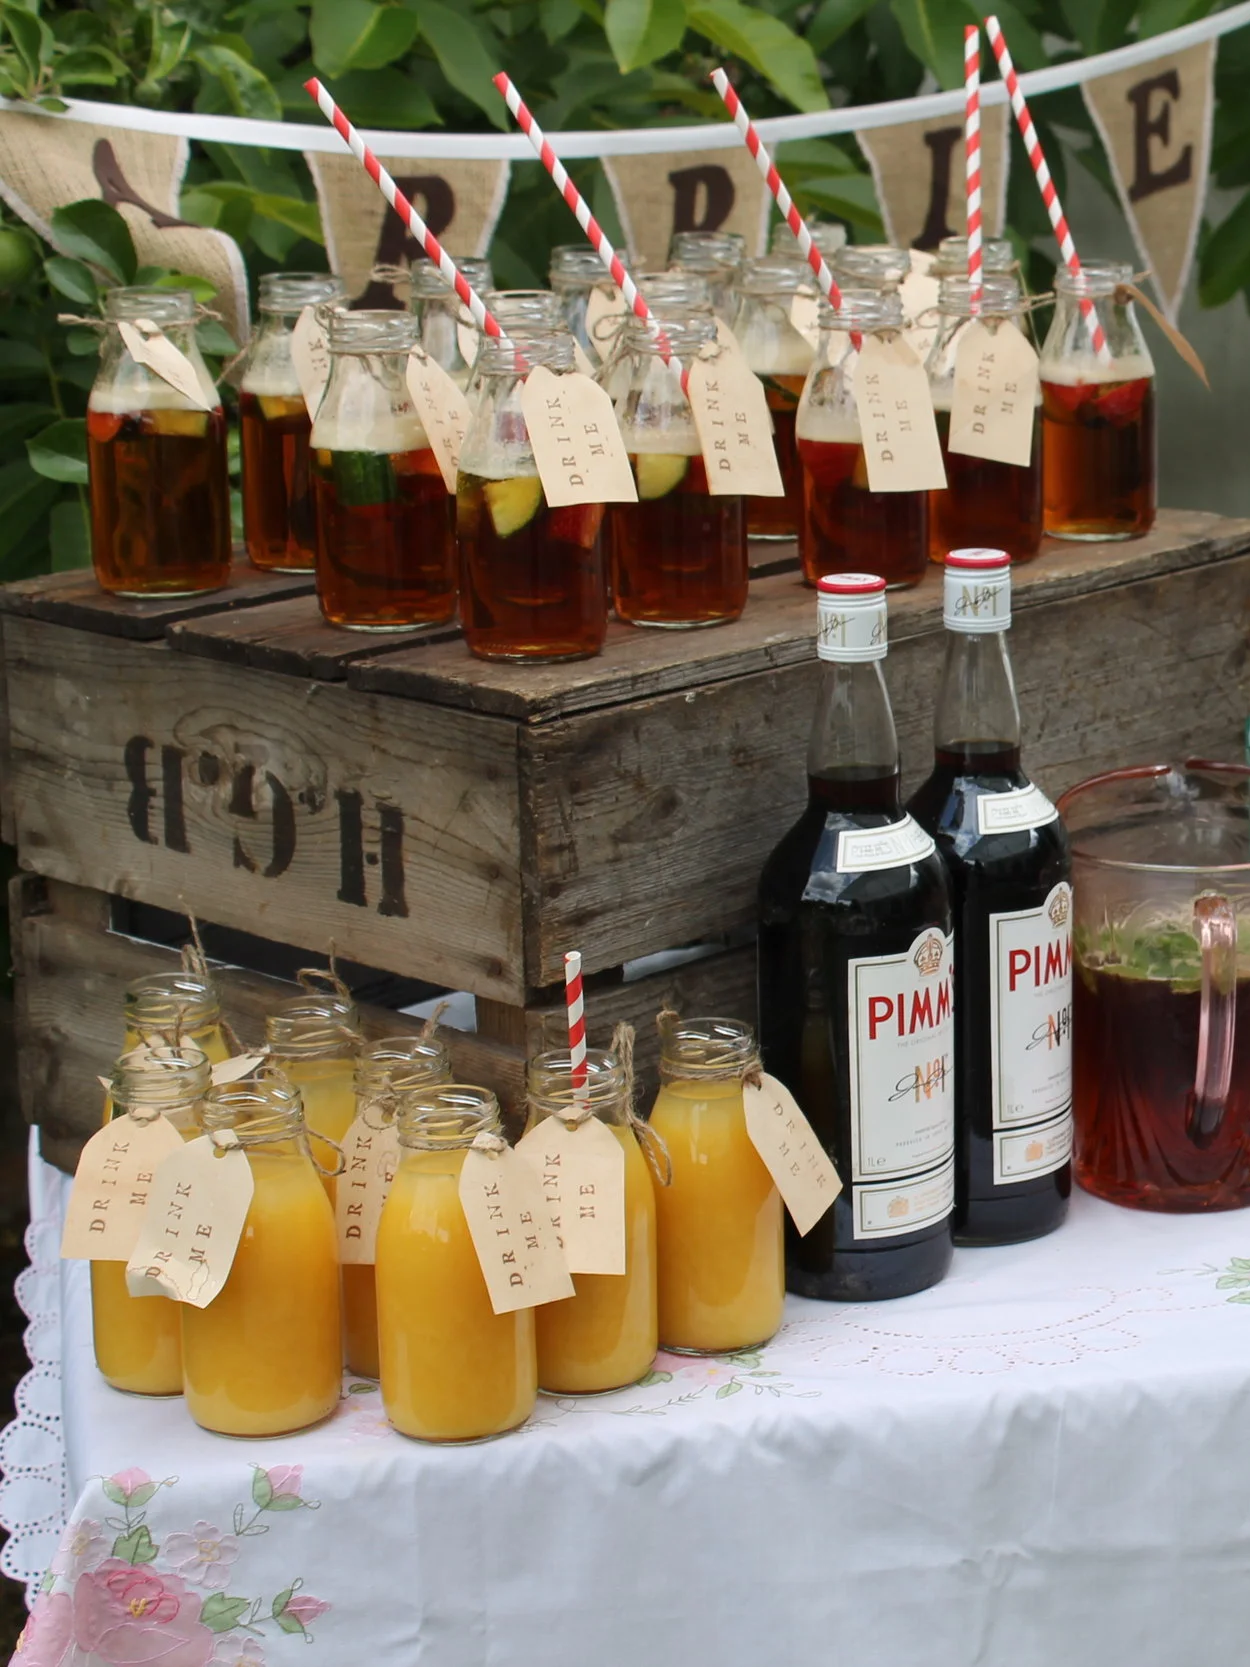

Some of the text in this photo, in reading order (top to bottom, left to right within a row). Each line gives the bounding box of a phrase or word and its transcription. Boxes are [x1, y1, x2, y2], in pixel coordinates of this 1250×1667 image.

[971, 351, 996, 435] DRINK
[1001, 382, 1018, 414] ME
[706, 380, 732, 472] DRINK
[735, 411, 750, 446] ME
[865, 373, 895, 463] DRINK
[895, 399, 912, 432] ME
[545, 396, 584, 487] DRINK
[585, 422, 605, 457] ME
[778, 1140, 800, 1177] ME
[89, 1141, 130, 1233] DRINK
[129, 1171, 153, 1206] ME
[345, 1135, 373, 1240] DRINK
[579, 1183, 596, 1219] ME
[145, 1181, 192, 1278] DRINK
[188, 1223, 213, 1265] ME
[483, 1181, 524, 1287] DRINK
[519, 1211, 540, 1250] ME
